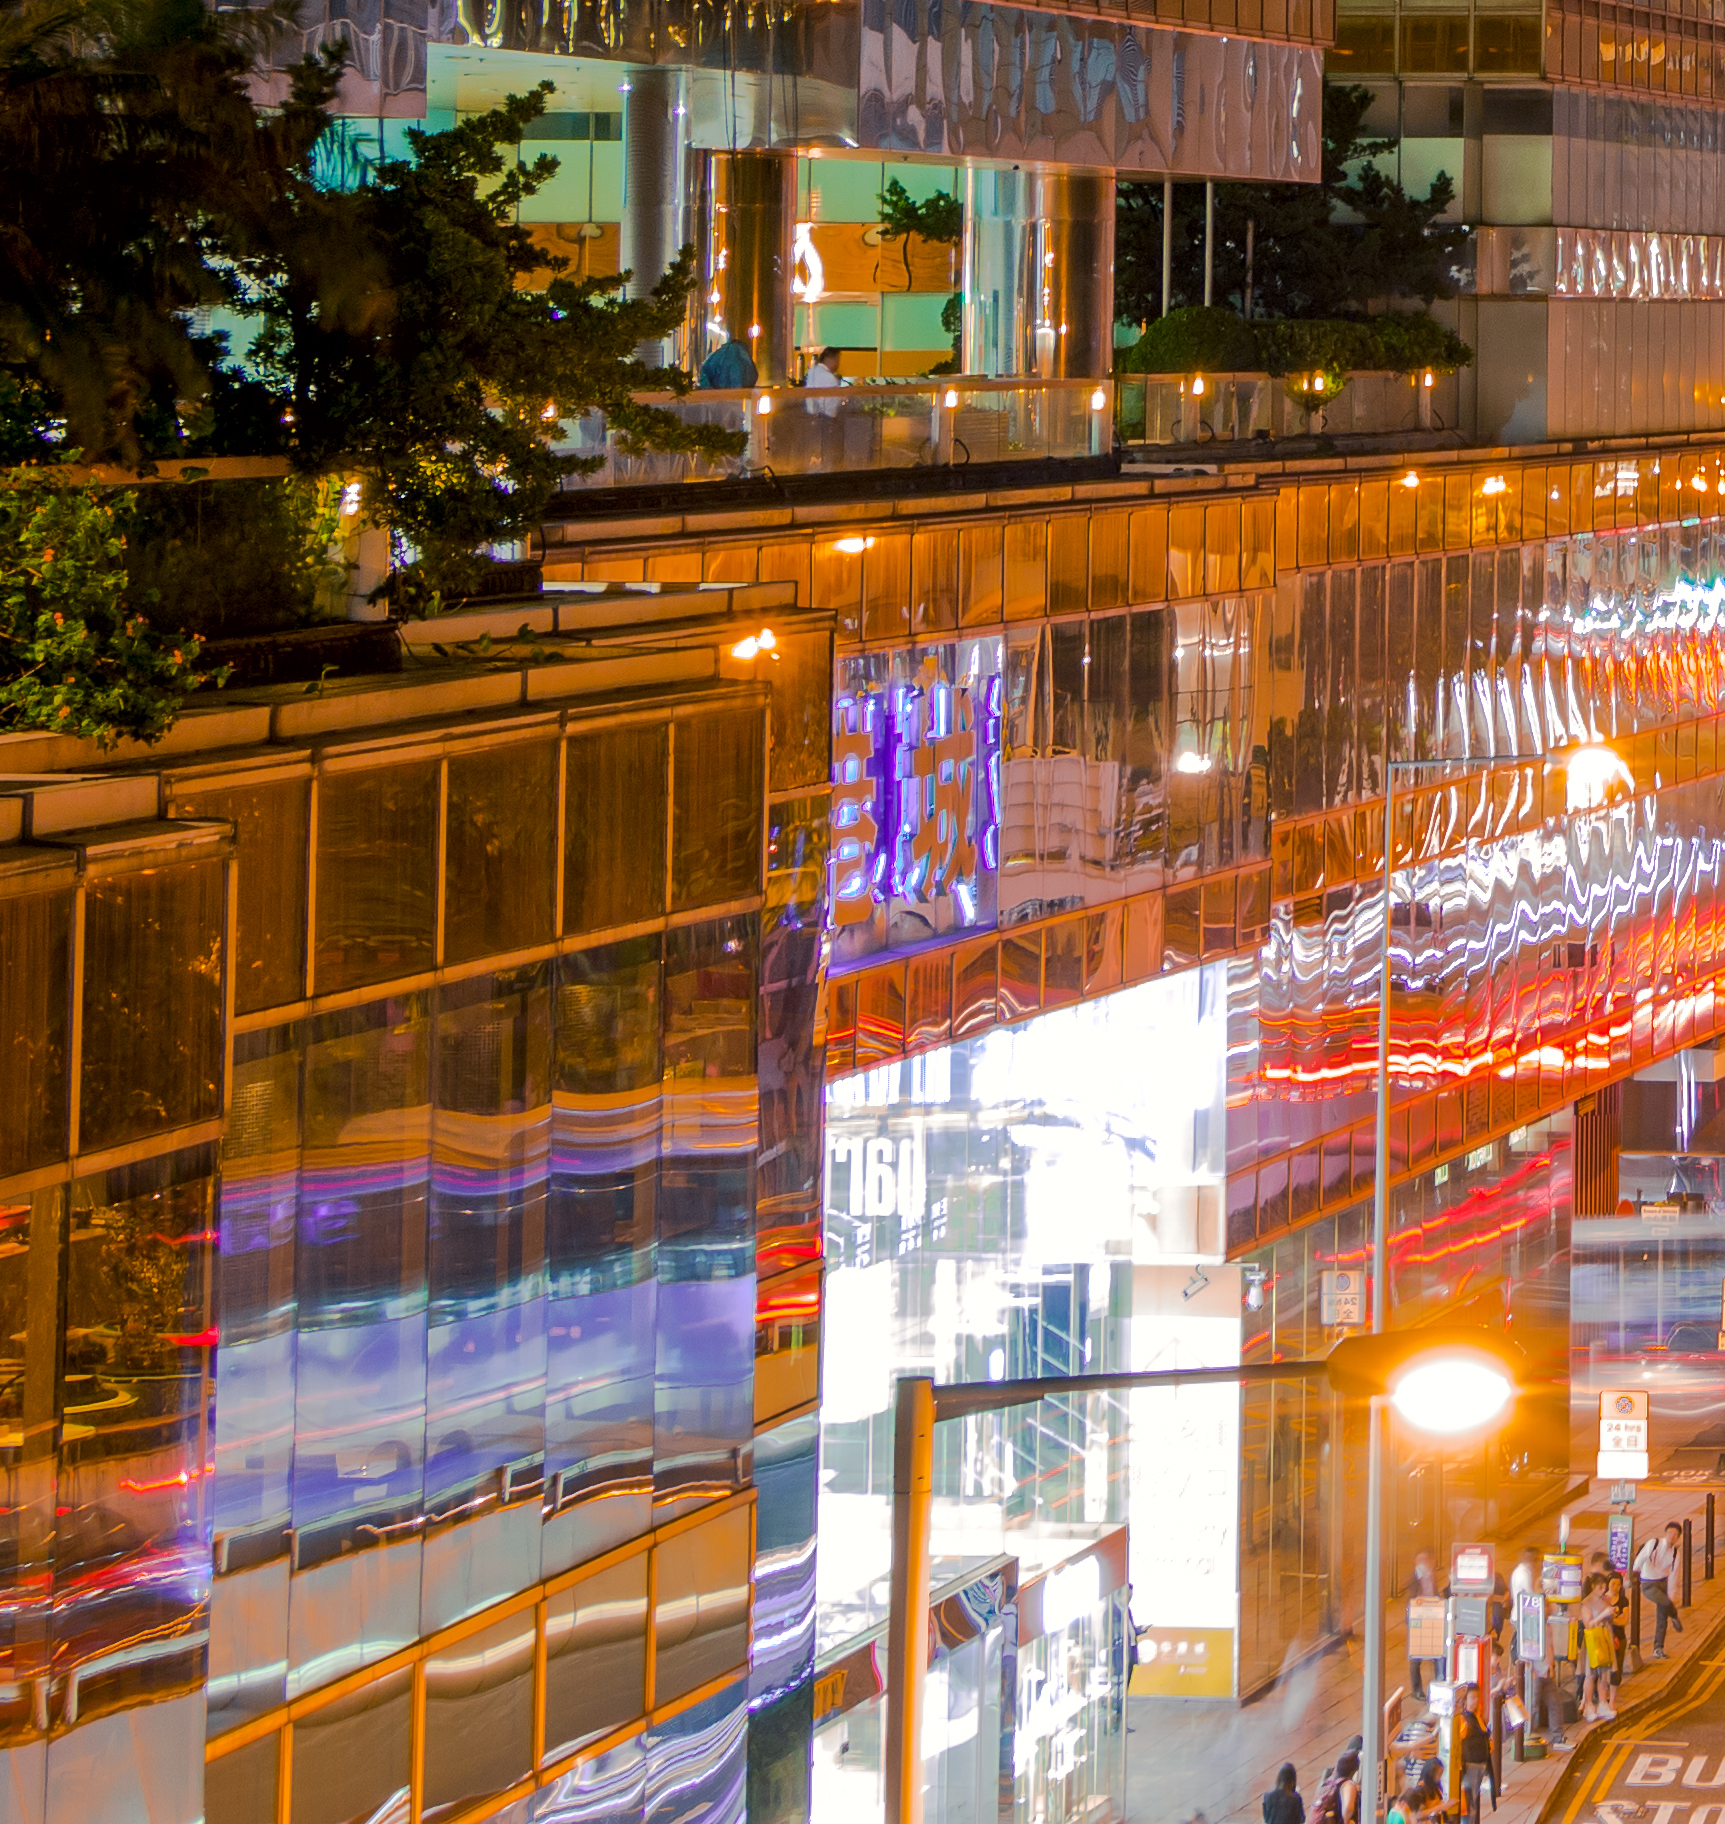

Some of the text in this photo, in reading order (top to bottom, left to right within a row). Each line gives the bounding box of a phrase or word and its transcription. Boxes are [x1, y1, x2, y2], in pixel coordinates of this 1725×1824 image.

[1607, 1423, 1642, 1432] 24 hrs
[1612, 1435, 1638, 1448] 全日
